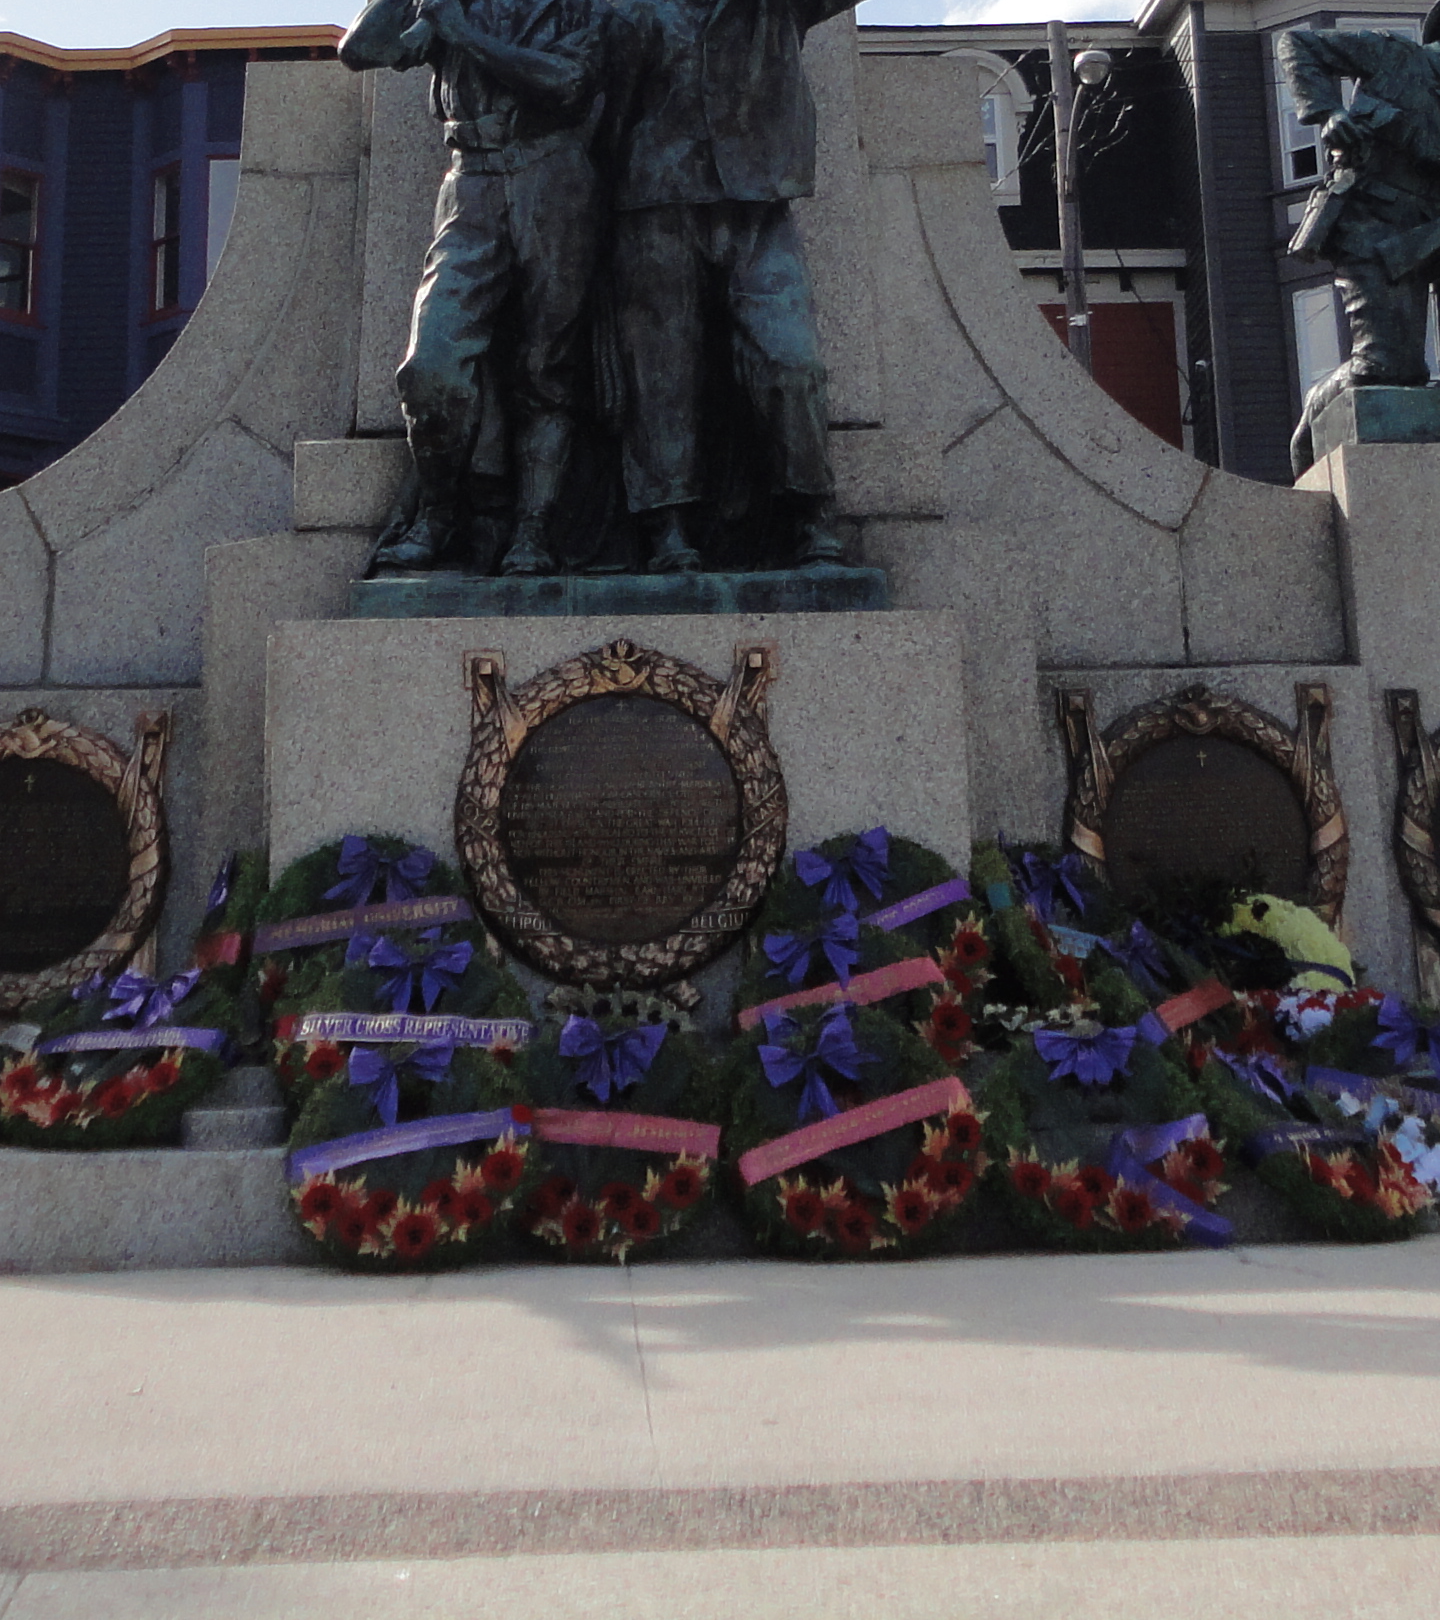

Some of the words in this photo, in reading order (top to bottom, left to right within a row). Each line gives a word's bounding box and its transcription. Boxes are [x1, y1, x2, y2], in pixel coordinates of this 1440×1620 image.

[690, 911, 748, 930] BELGIU
[299, 1018, 353, 1036] SILVER
[354, 1016, 402, 1036] CROSS
[403, 1017, 531, 1043] REPRESENTATIVE
